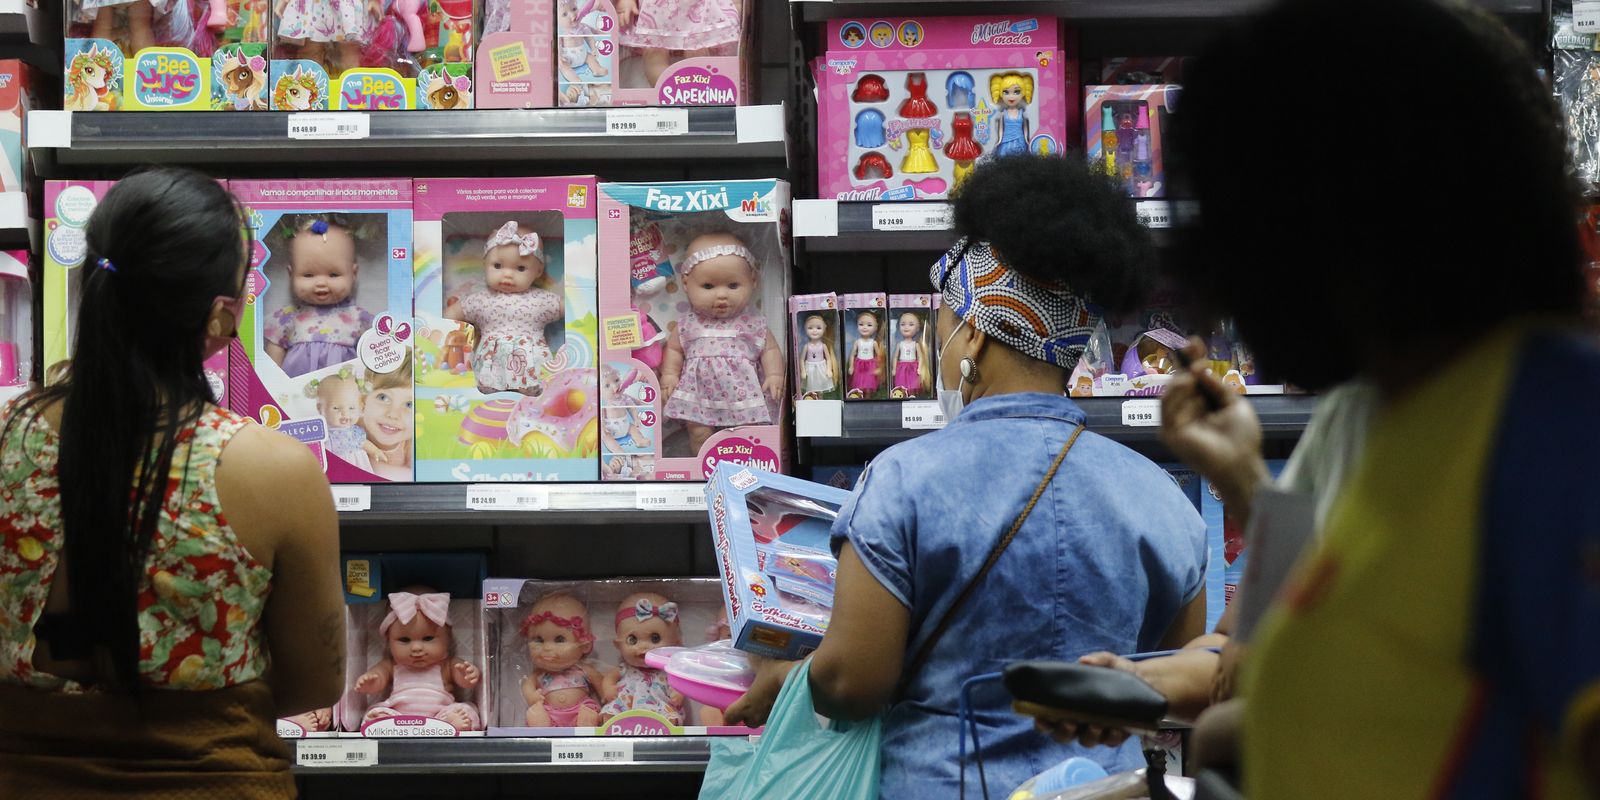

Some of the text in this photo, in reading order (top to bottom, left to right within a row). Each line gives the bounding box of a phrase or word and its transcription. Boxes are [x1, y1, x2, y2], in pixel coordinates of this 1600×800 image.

[605, 18, 610, 28] 1
[993, 32, 1032, 45] moda
[604, 43, 611, 53] 2
[157, 55, 190, 75] Bee
[674, 74, 711, 85] Faz Xixi
[362, 75, 395, 95] Bee
[661, 85, 735, 105] SAPEKINHA
[620, 122, 637, 130] 29.99
[286, 188, 335, 197] compartilhar
[336, 188, 358, 196] lindos
[645, 187, 729, 211] Faz Xixi
[393, 249, 405, 258] 3+
[369, 339, 391, 350] Quero
[375, 346, 390, 355] ficar
[384, 350, 397, 358] seu
[374, 354, 401, 369] colinho!
[1104, 375, 1124, 383] Company
[647, 414, 654, 424] 2
[281, 424, 319, 436] OLEÇÃO
[717, 445, 753, 456] Faz Xixi
[487, 593, 498, 601] 3+
[752, 602, 802, 625] Bethany
[396, 718, 423, 726] COLEÇÃO
[277, 727, 301, 736] sicas
[367, 727, 454, 736] Milkinhas Clássicas
[558, 752, 566, 760] R$
